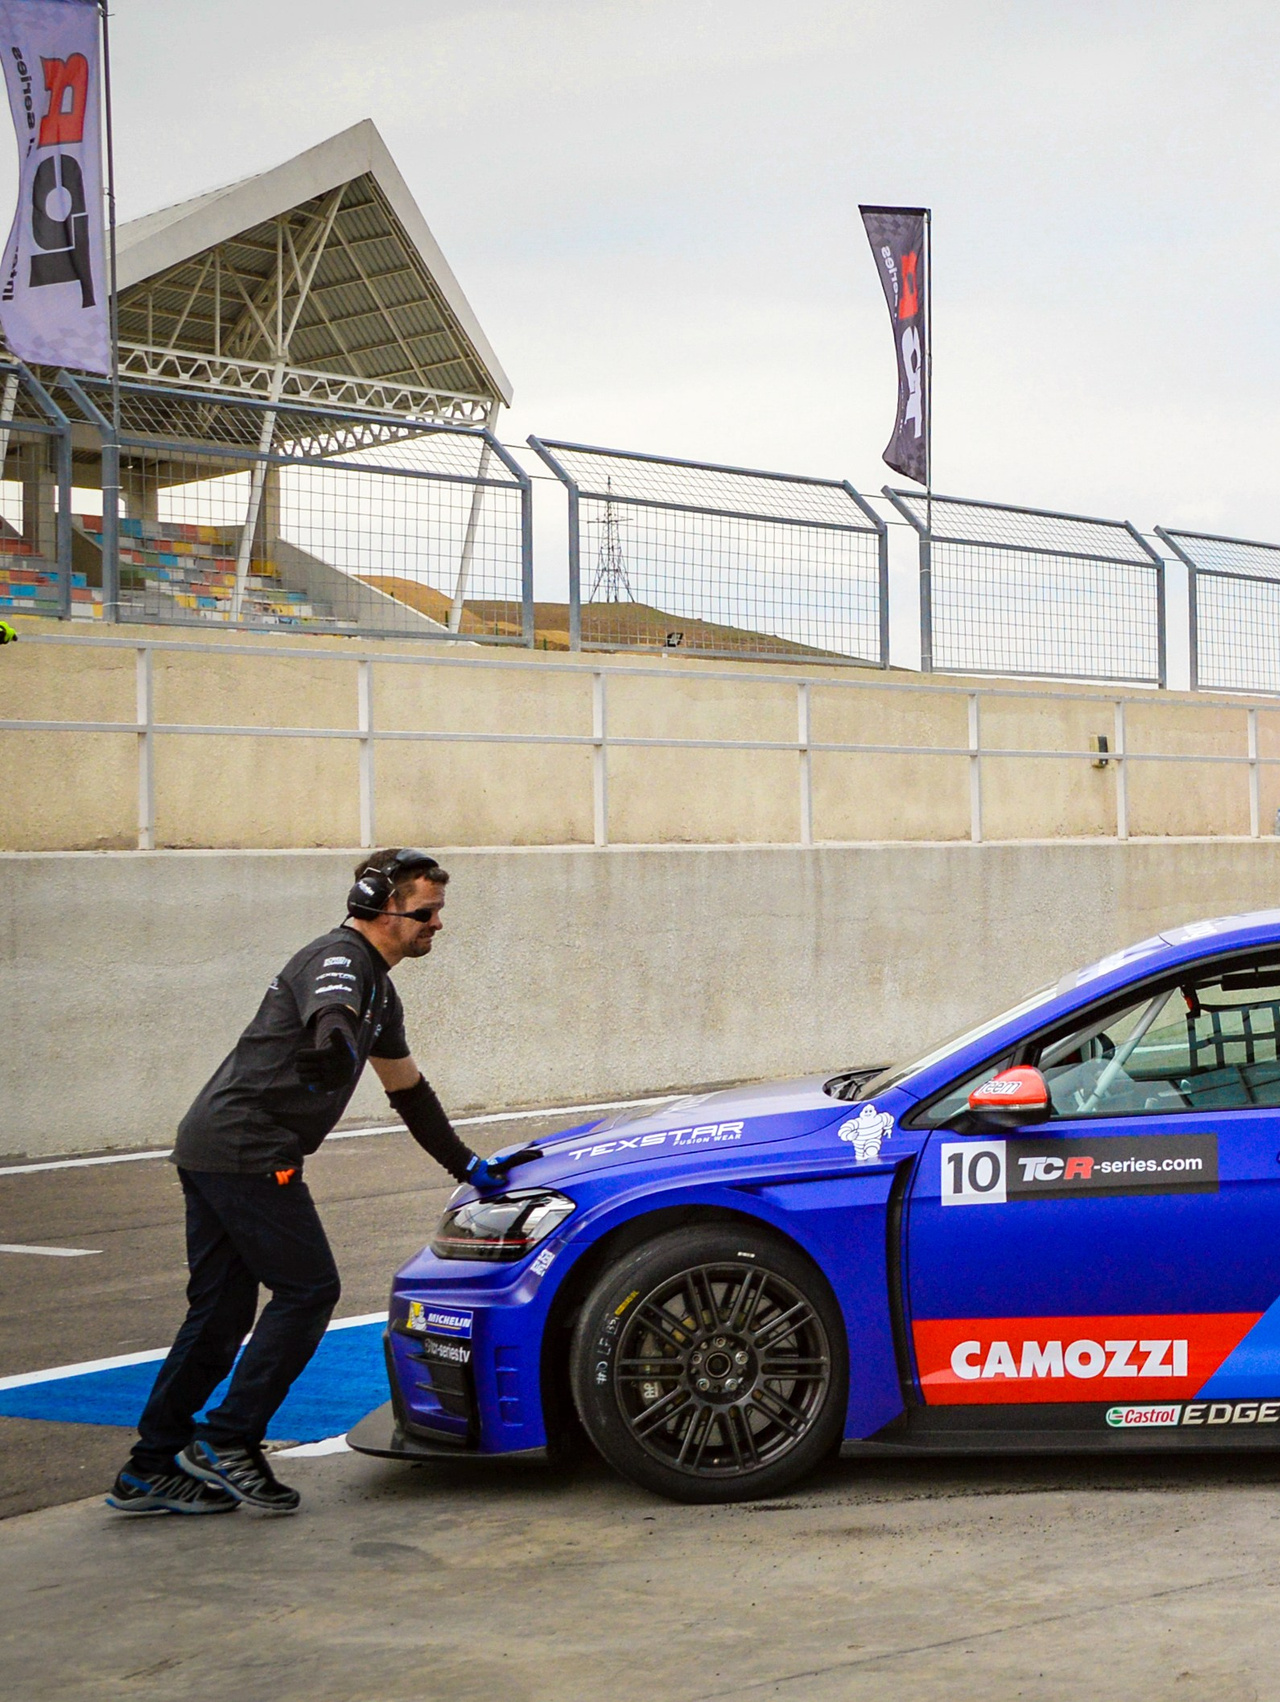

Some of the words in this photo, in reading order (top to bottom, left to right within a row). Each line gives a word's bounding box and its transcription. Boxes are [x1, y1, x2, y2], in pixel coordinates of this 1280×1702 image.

[568, 1121, 744, 1161] TEXSTAR
[673, 1136, 710, 1147] FUSION
[713, 1133, 742, 1142] WEAR
[947, 1151, 1001, 1195] 10
[1018, 1156, 1203, 1182] TCR-series.com
[428, 1313, 471, 1328] MICHELIN
[950, 1340, 1188, 1380] CAMOZZI
[1124, 1409, 1175, 1424] Castrol
